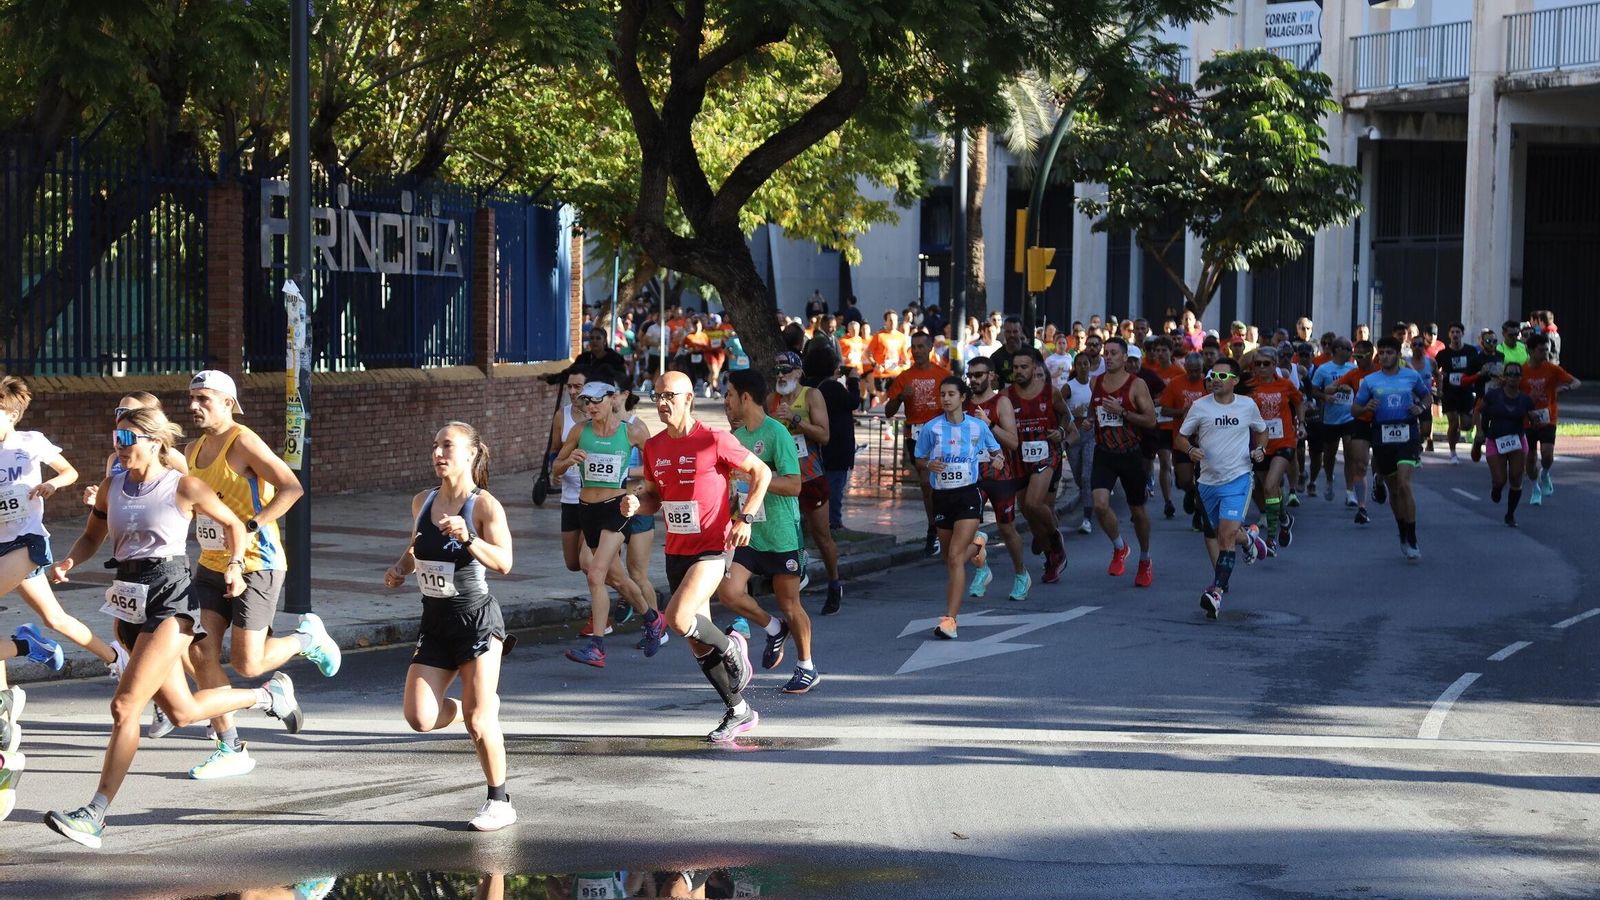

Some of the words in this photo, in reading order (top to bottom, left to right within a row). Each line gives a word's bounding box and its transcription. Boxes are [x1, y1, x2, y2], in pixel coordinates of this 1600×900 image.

[1265, 12, 1297, 25] CORNER
[1300, 11, 1314, 22] VIP
[1265, 24, 1313, 38] MALAGUISTA
[1214, 415, 1239, 426] nike
[1024, 447, 1043, 456] 787
[589, 463, 614, 473] 828
[941, 471, 963, 480] 938
[668, 512, 691, 524] 882
[197, 527, 217, 540] 950
[421, 573, 446, 588] 110
[111, 594, 137, 611] 464
